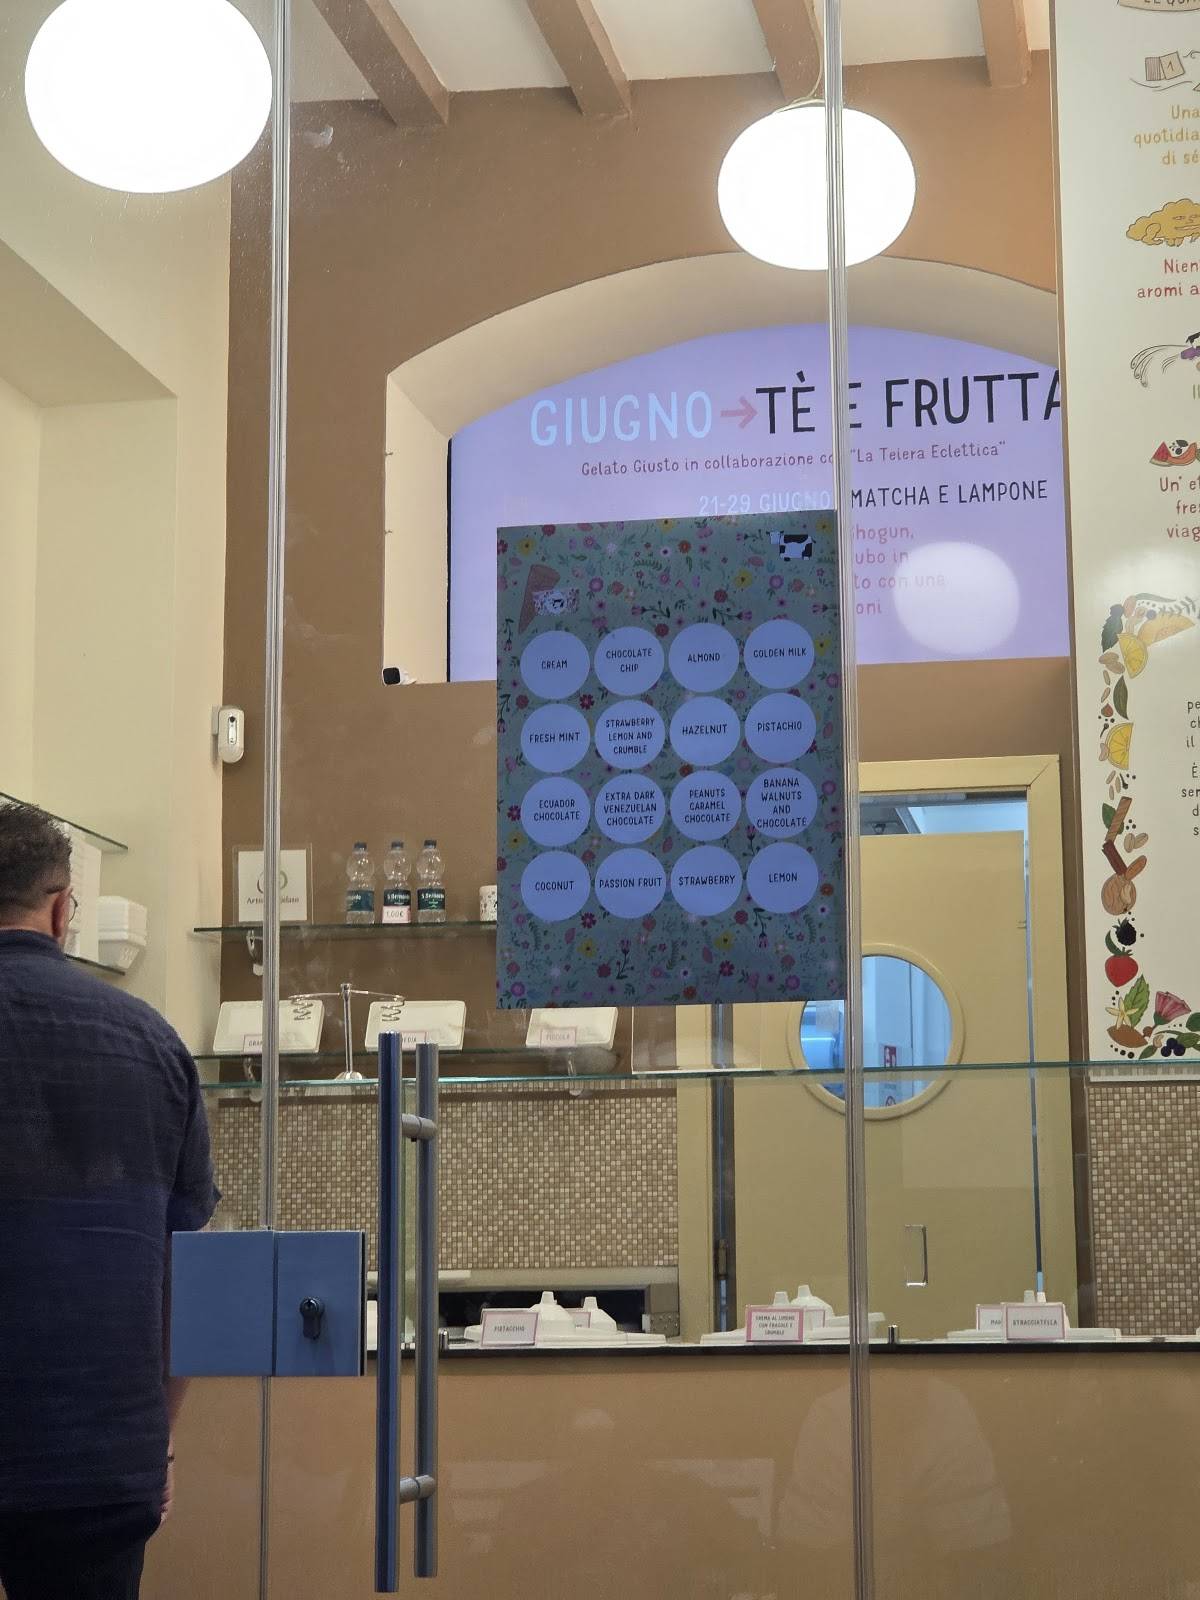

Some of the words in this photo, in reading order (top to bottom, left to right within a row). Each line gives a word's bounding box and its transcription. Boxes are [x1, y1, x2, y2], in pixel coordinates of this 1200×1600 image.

[1171, 104, 1200, 120] Una
[1162, 150, 1177, 166] di
[1137, 282, 1183, 299] aromi
[530, 390, 713, 447] GIUGNO
[755, 370, 815, 434] TÈ
[885, 369, 1061, 428] FRUTTA
[581, 460, 628, 477] Gelato
[633, 456, 679, 474] Giusto
[685, 457, 699, 471] in
[704, 452, 813, 470] collaborazione
[880, 446, 925, 462] Teiera
[931, 440, 1006, 458] Eclettica"
[699, 493, 750, 515] 21-29
[759, 490, 831, 512] GIUGNO
[851, 485, 930, 509] MATCHA
[938, 485, 949, 504] E
[958, 479, 1048, 504] LAMPONE
[1176, 499, 1200, 515] fre
[852, 523, 914, 545] hogun,
[605, 648, 653, 659] CHOCOLATE
[687, 652, 721, 663] ALMOND
[753, 648, 785, 658] GOLDEN
[788, 647, 807, 656] MILK
[541, 659, 568, 670] CREAM
[620, 663, 639, 673] CHIP
[605, 717, 655, 728] STRAWBERRY
[757, 721, 803, 732] PISTACHIO
[682, 723, 728, 735] HAZELNUT
[529, 733, 556, 743] FRESH
[559, 732, 580, 743] MINT
[608, 732, 634, 742] LEMON
[636, 731, 653, 740] AND
[613, 744, 647, 755] CRUMBLE
[763, 777, 800, 788] BANANA
[605, 791, 631, 801] EXTRA
[634, 790, 655, 800] DARK
[689, 788, 726, 799] PEANUTS
[761, 791, 802, 802] WALNUTS
[539, 799, 575, 809] ECUADOR
[604, 803, 657, 814] VENEZUELAN
[689, 801, 725, 811] CARAMEL
[773, 804, 791, 814] AND
[533, 811, 580, 821] CHOCOLATE
[606, 816, 654, 826] CHOCOLATE
[684, 813, 731, 823] CHOCOLATE
[756, 817, 808, 828] CHOCOLATE
[599, 878, 635, 889] PASSION
[638, 877, 662, 887] FRUIT
[678, 875, 736, 886] STRAWBERRY
[768, 872, 798, 883] LEMON
[535, 880, 575, 891] COCONUT
